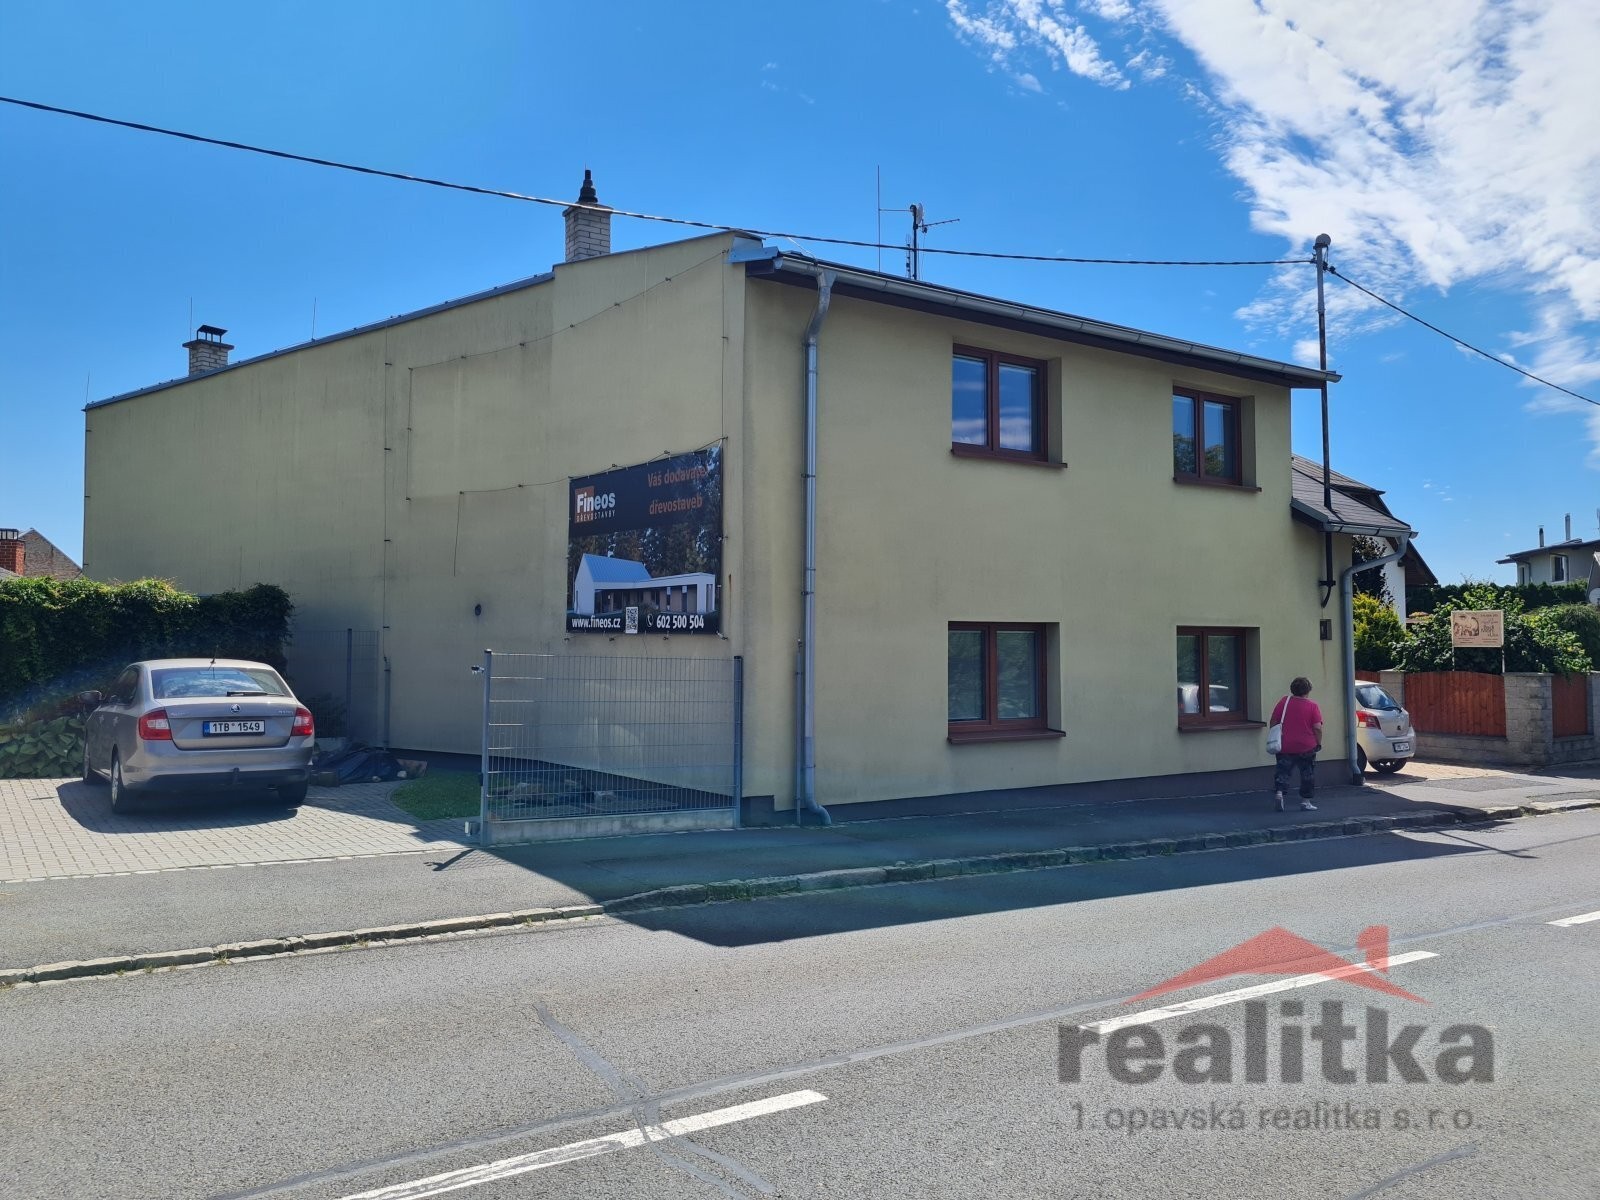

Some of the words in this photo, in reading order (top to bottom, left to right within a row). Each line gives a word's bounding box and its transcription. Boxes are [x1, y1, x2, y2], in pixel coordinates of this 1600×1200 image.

[648, 471, 662, 488] Váš
[576, 491, 616, 513] Fineos
[649, 493, 703, 515] dřevostaveb
[572, 615, 621, 628] www.fineos.cz
[656, 615, 671, 629] 602
[672, 615, 687, 629] 500
[689, 614, 704, 629] 504
[212, 722, 230, 733] 1TB
[237, 722, 261, 732] 1549
